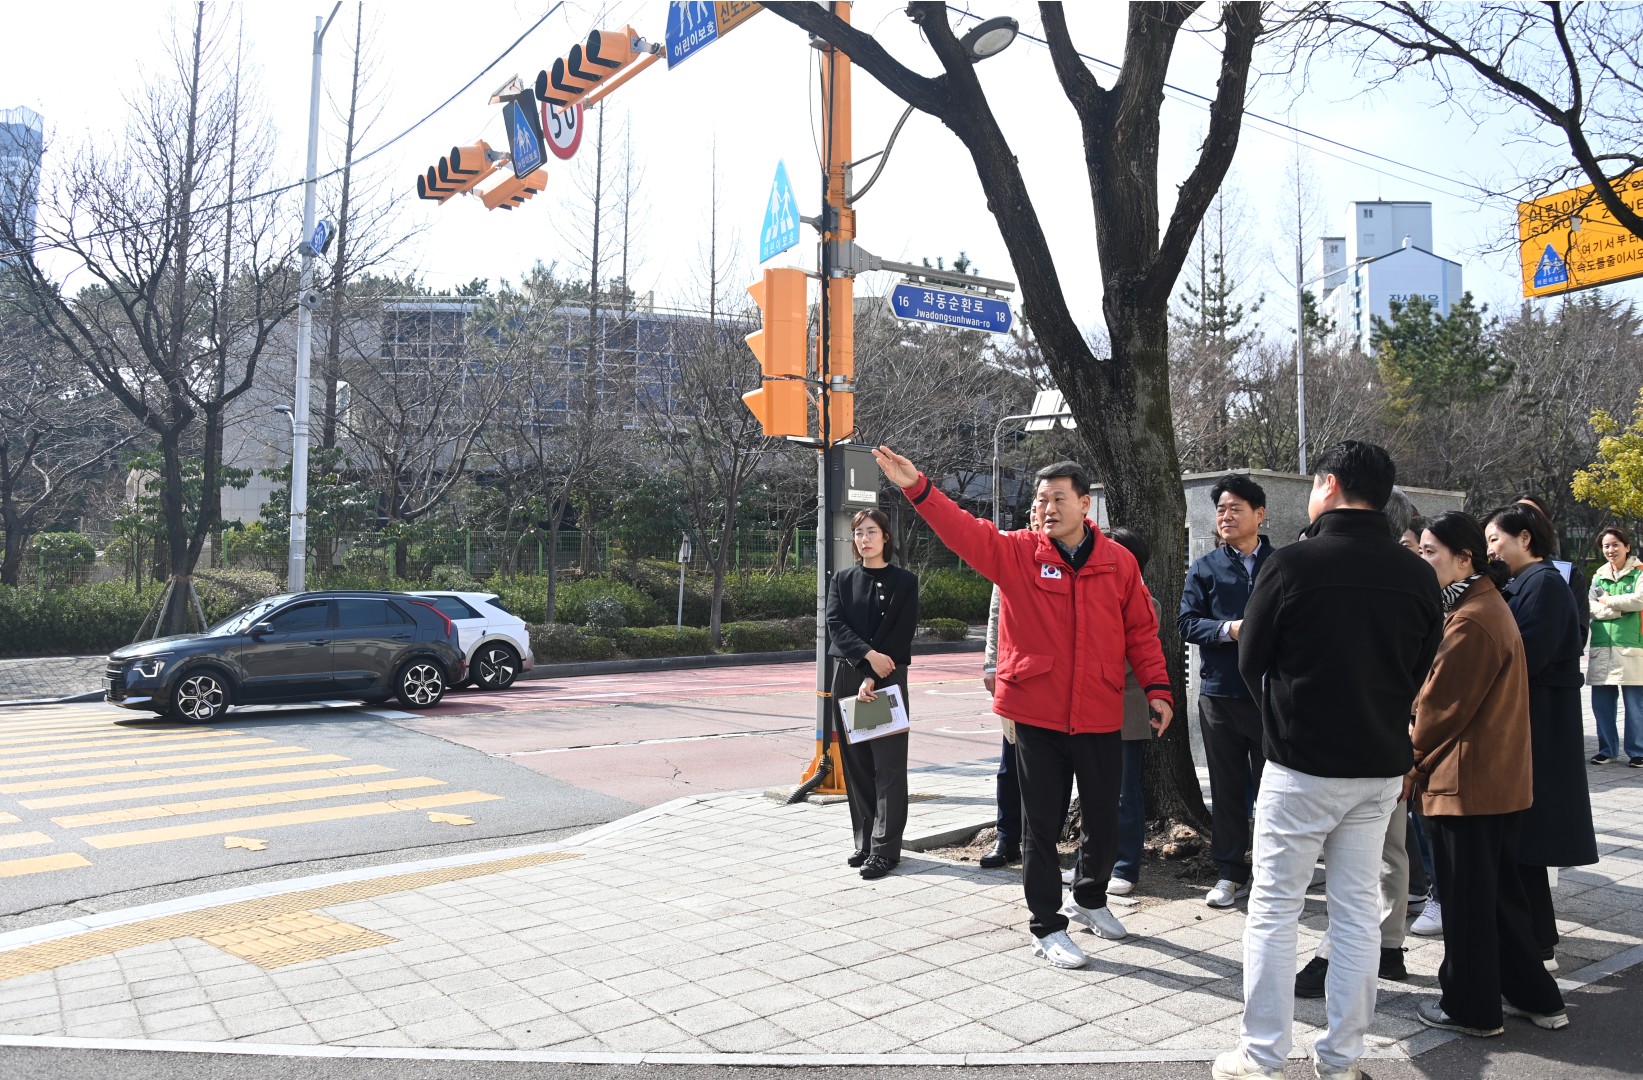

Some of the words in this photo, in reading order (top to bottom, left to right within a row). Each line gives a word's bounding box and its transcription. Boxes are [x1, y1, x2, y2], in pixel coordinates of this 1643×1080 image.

[674, 20, 715, 57] 어린이보호
[1582, 233, 1639, 254] 여기서부터
[898, 295, 910, 308] 16
[923, 291, 984, 313] 좌동순환로
[915, 308, 991, 328] Jwadongsunhwan-ro
[995, 311, 1006, 323] 18
